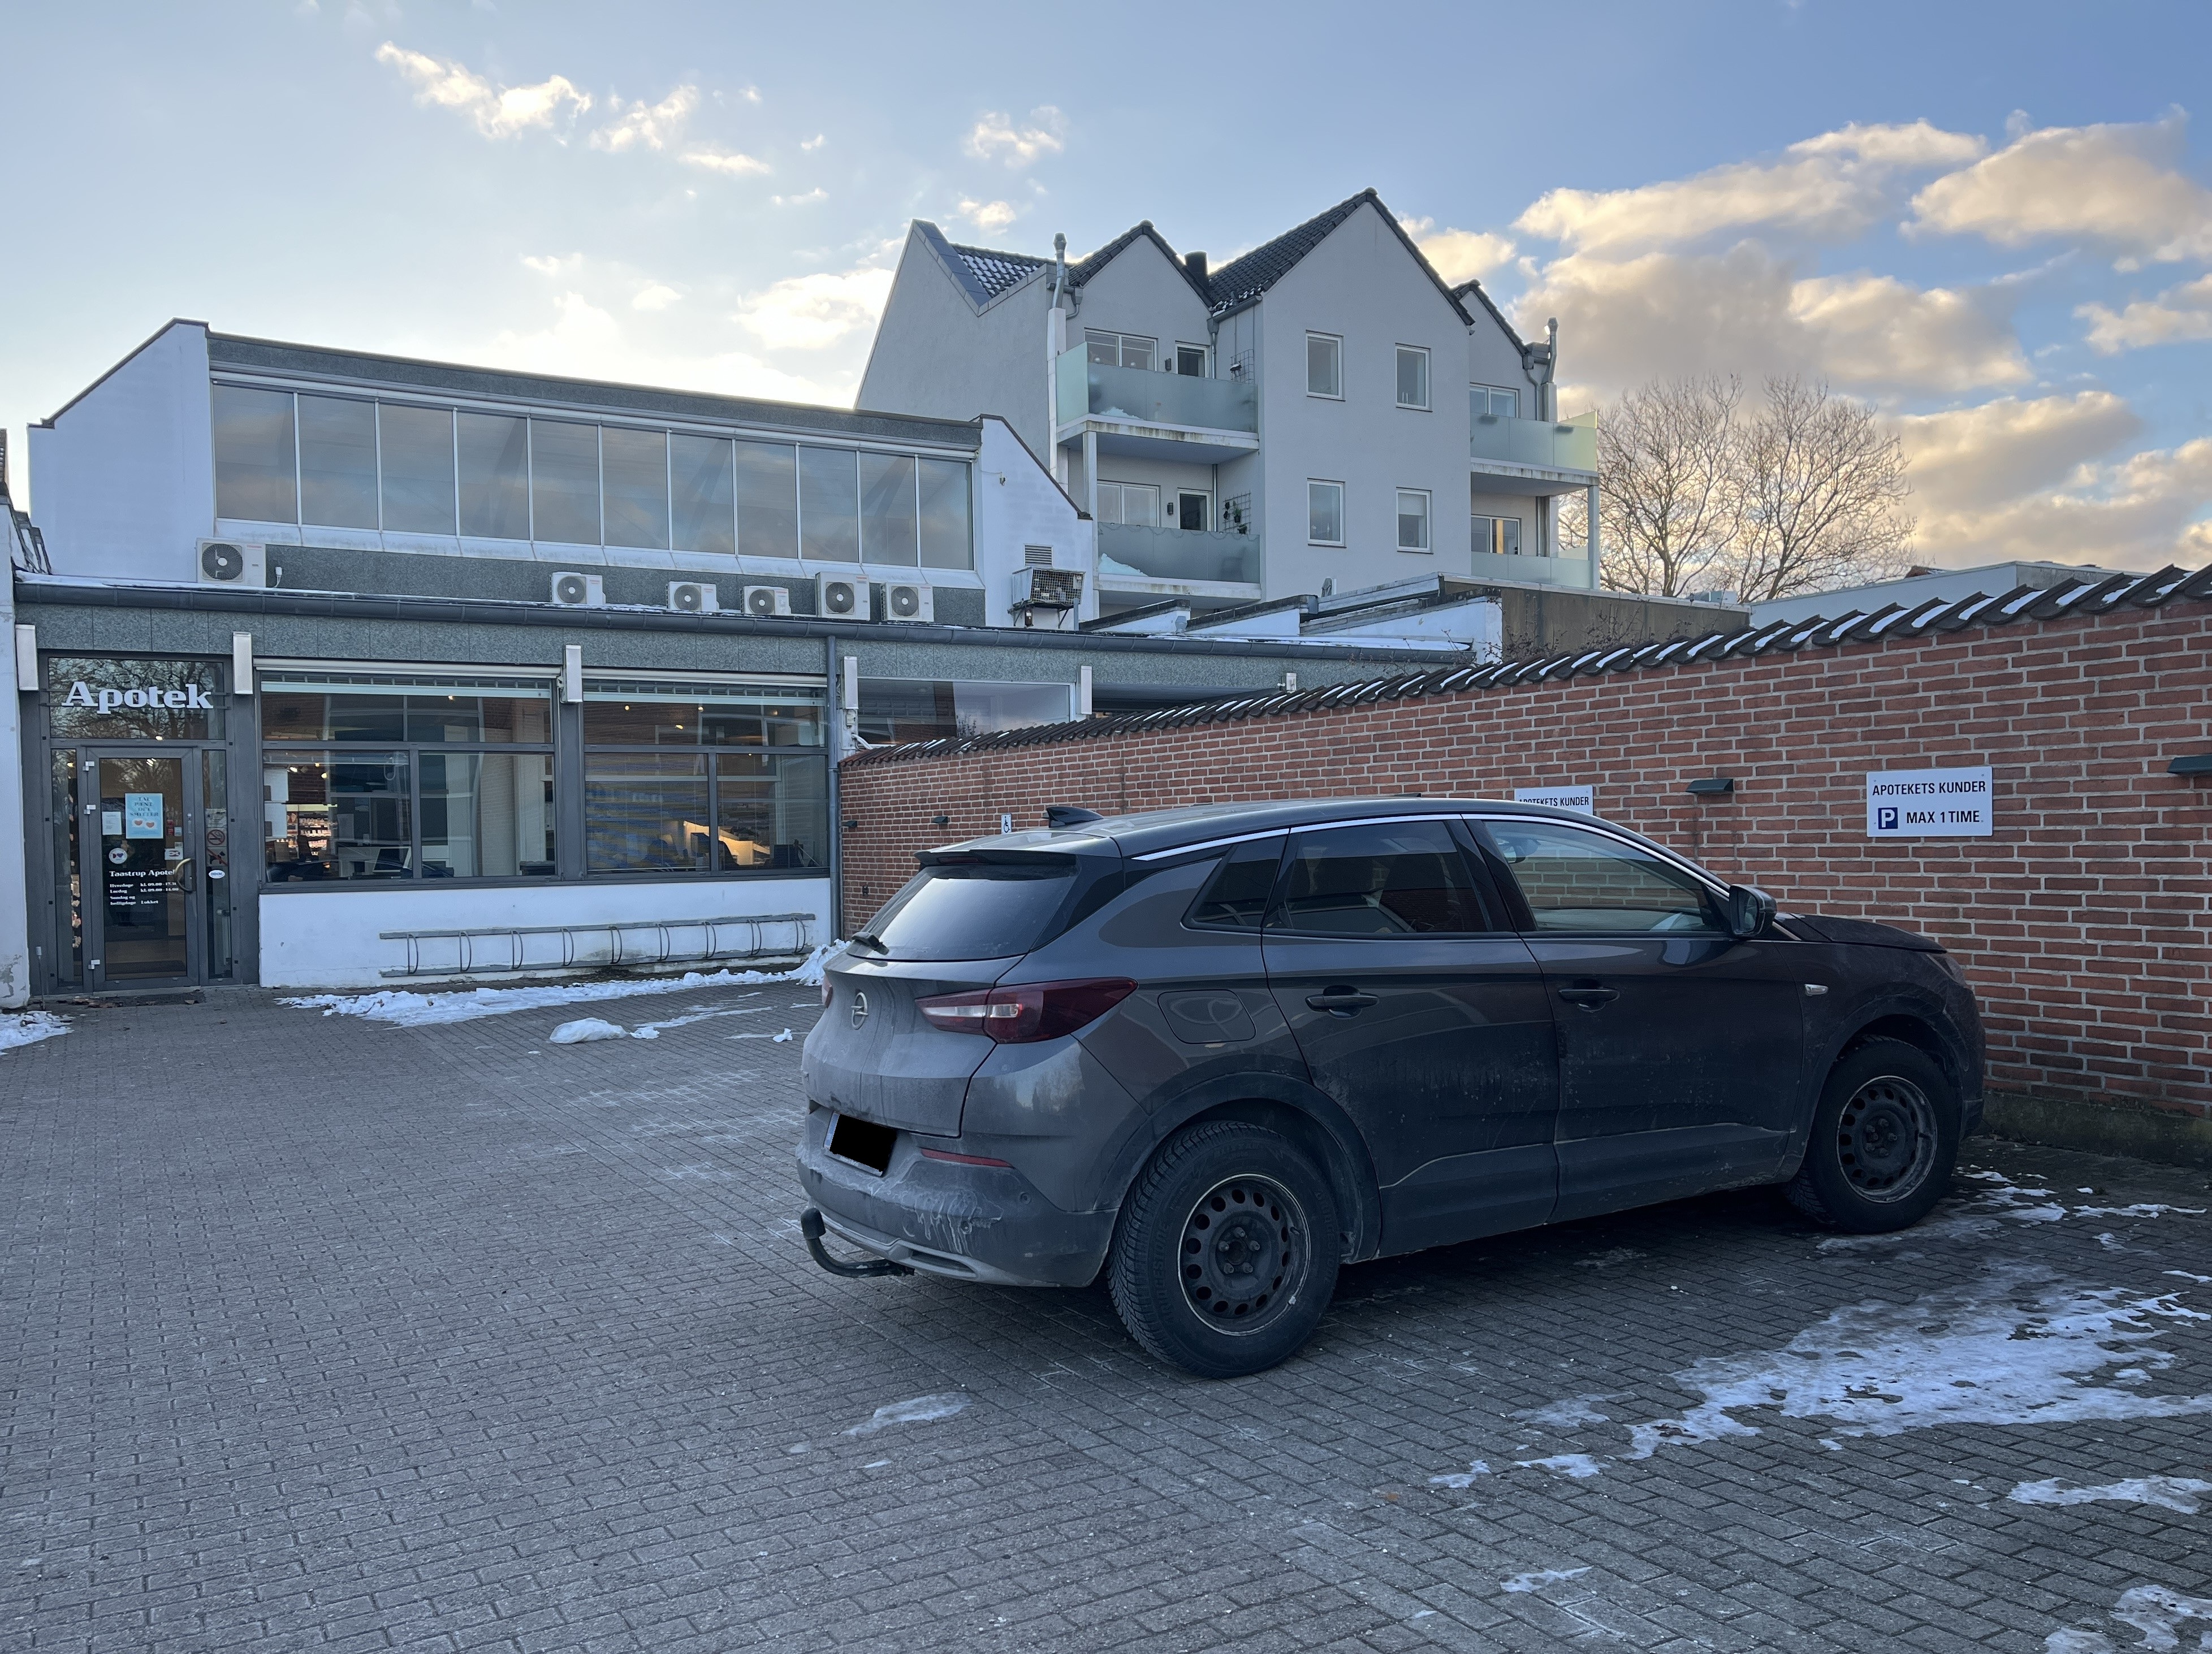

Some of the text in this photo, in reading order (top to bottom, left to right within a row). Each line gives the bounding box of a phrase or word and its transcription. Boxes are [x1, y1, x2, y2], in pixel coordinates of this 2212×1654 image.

[61, 681, 214, 715] Apotek
[1872, 781, 1986, 796] APOTEKETS KUNDER
[1560, 796, 1589, 807] KUNDER
[1906, 812, 1936, 824] MAX
[1940, 812, 1946, 823] 1
[1948, 810, 1980, 823] TIME
